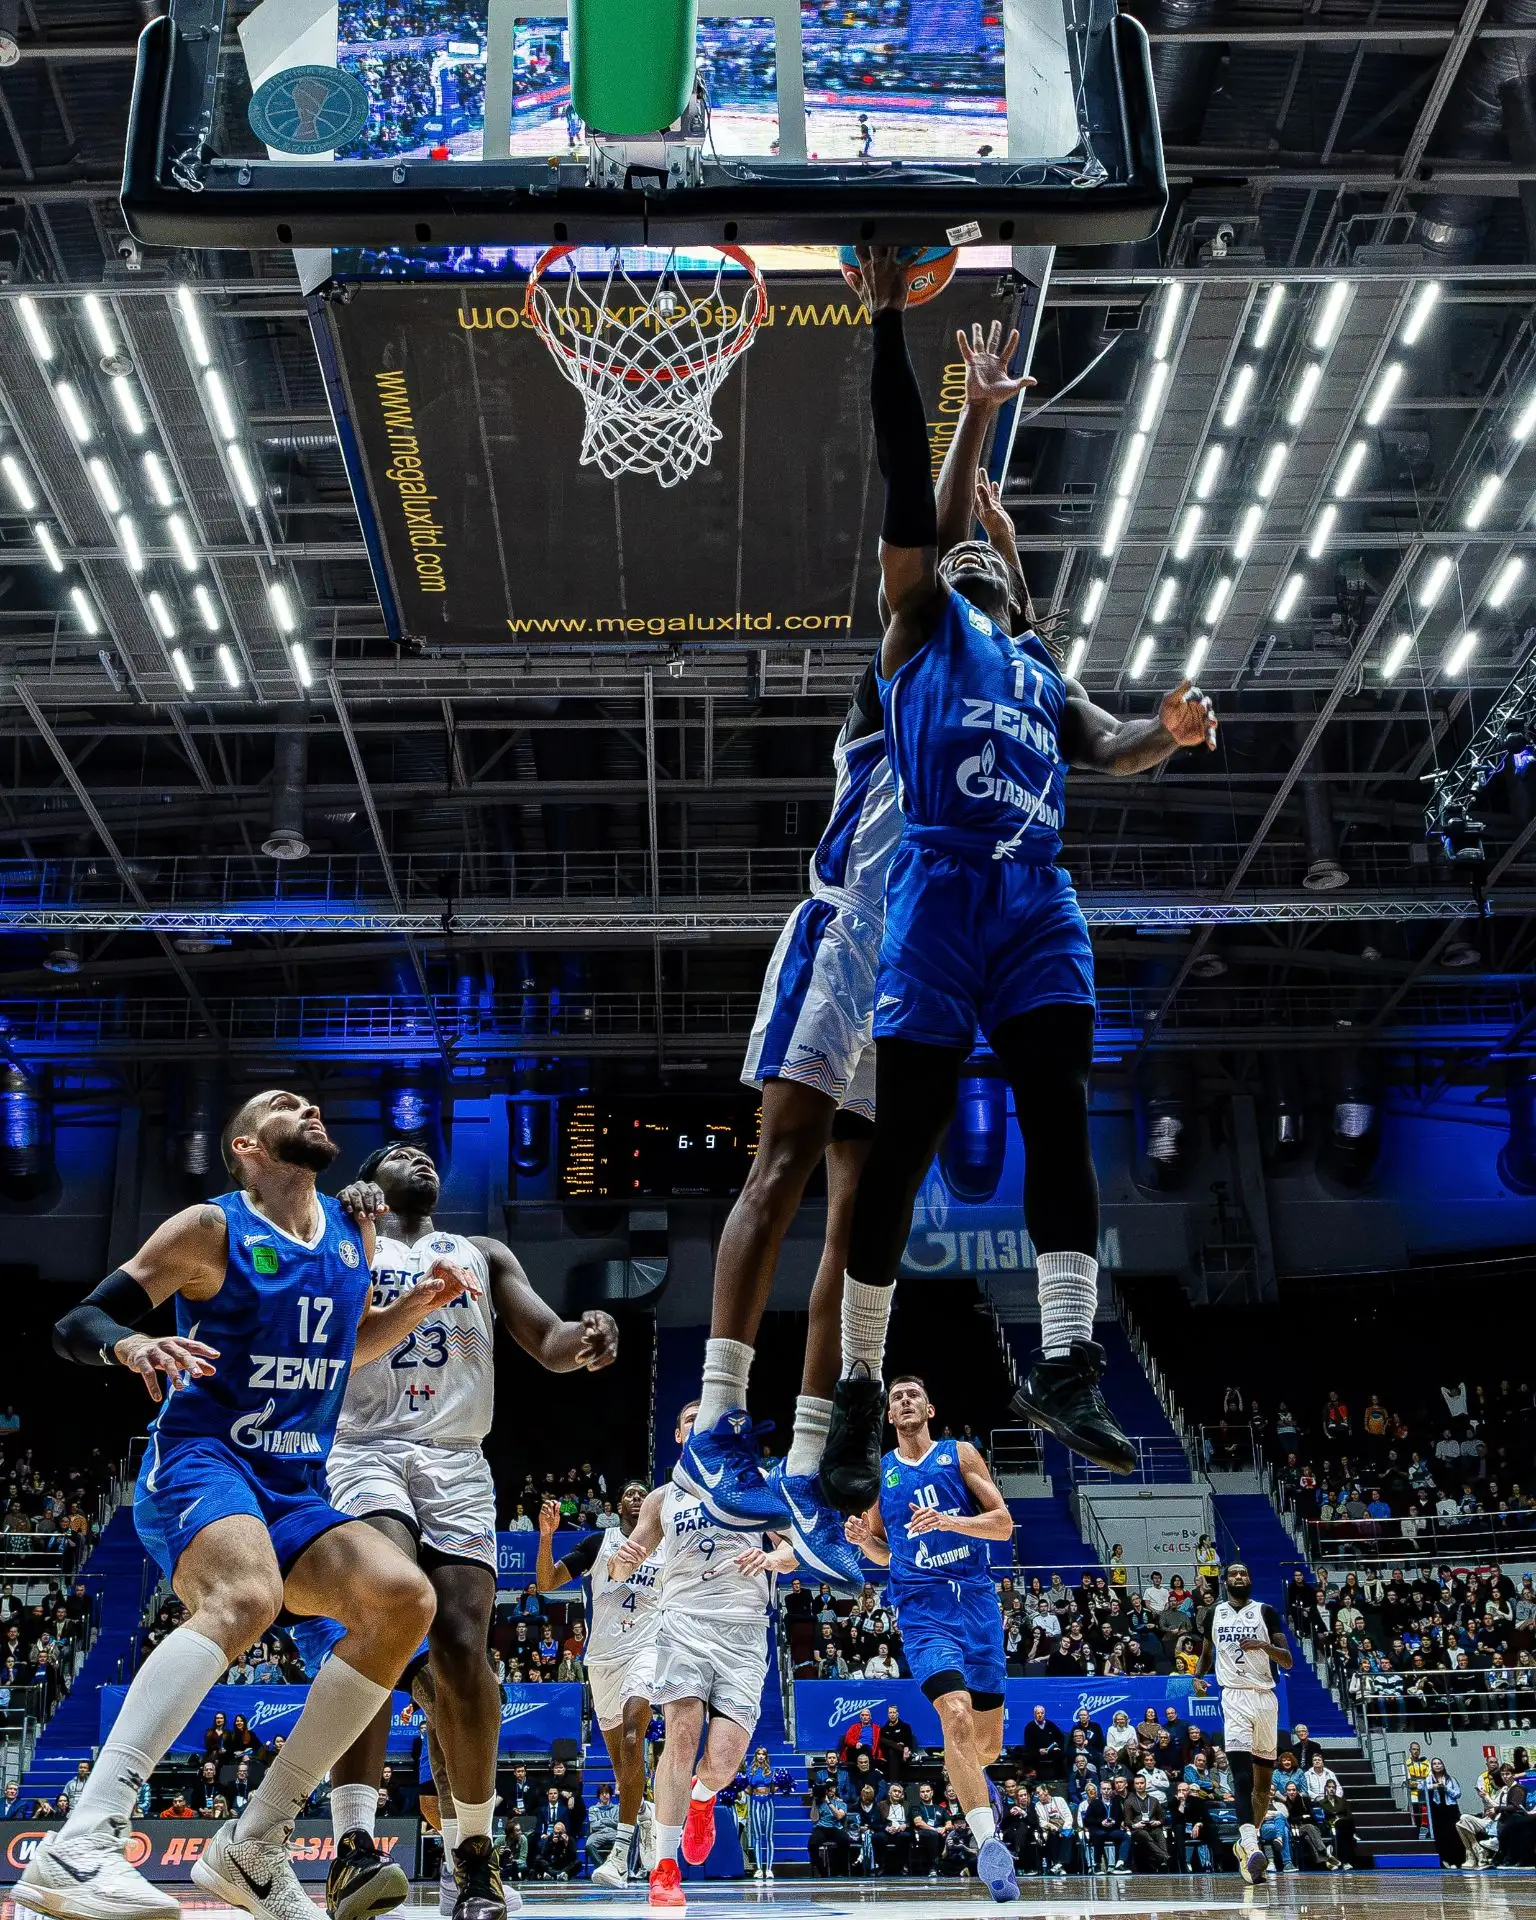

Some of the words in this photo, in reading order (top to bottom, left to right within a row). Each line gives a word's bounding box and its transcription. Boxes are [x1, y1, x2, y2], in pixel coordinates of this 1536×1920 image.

[375, 370, 447, 592] www.megaluxltd.com
[506, 612, 853, 636] www.megaluxltd.com
[1010, 659, 1045, 708] 11
[706, 1134, 715, 1149] 9
[958, 1229, 1122, 1270] ГАЗПМ
[297, 1296, 334, 1343] 12
[390, 1327, 450, 1369] 23
[248, 1355, 347, 1391] ZENIT
[913, 1483, 940, 1509] 10
[699, 1538, 716, 1562] 9
[931, 1545, 971, 1569] ГАЗПРОМ
[621, 1592, 637, 1613] 4
[1217, 1626, 1258, 1634] BETCITY
[1234, 1648, 1246, 1665] 2
[500, 1702, 550, 1725] енит
